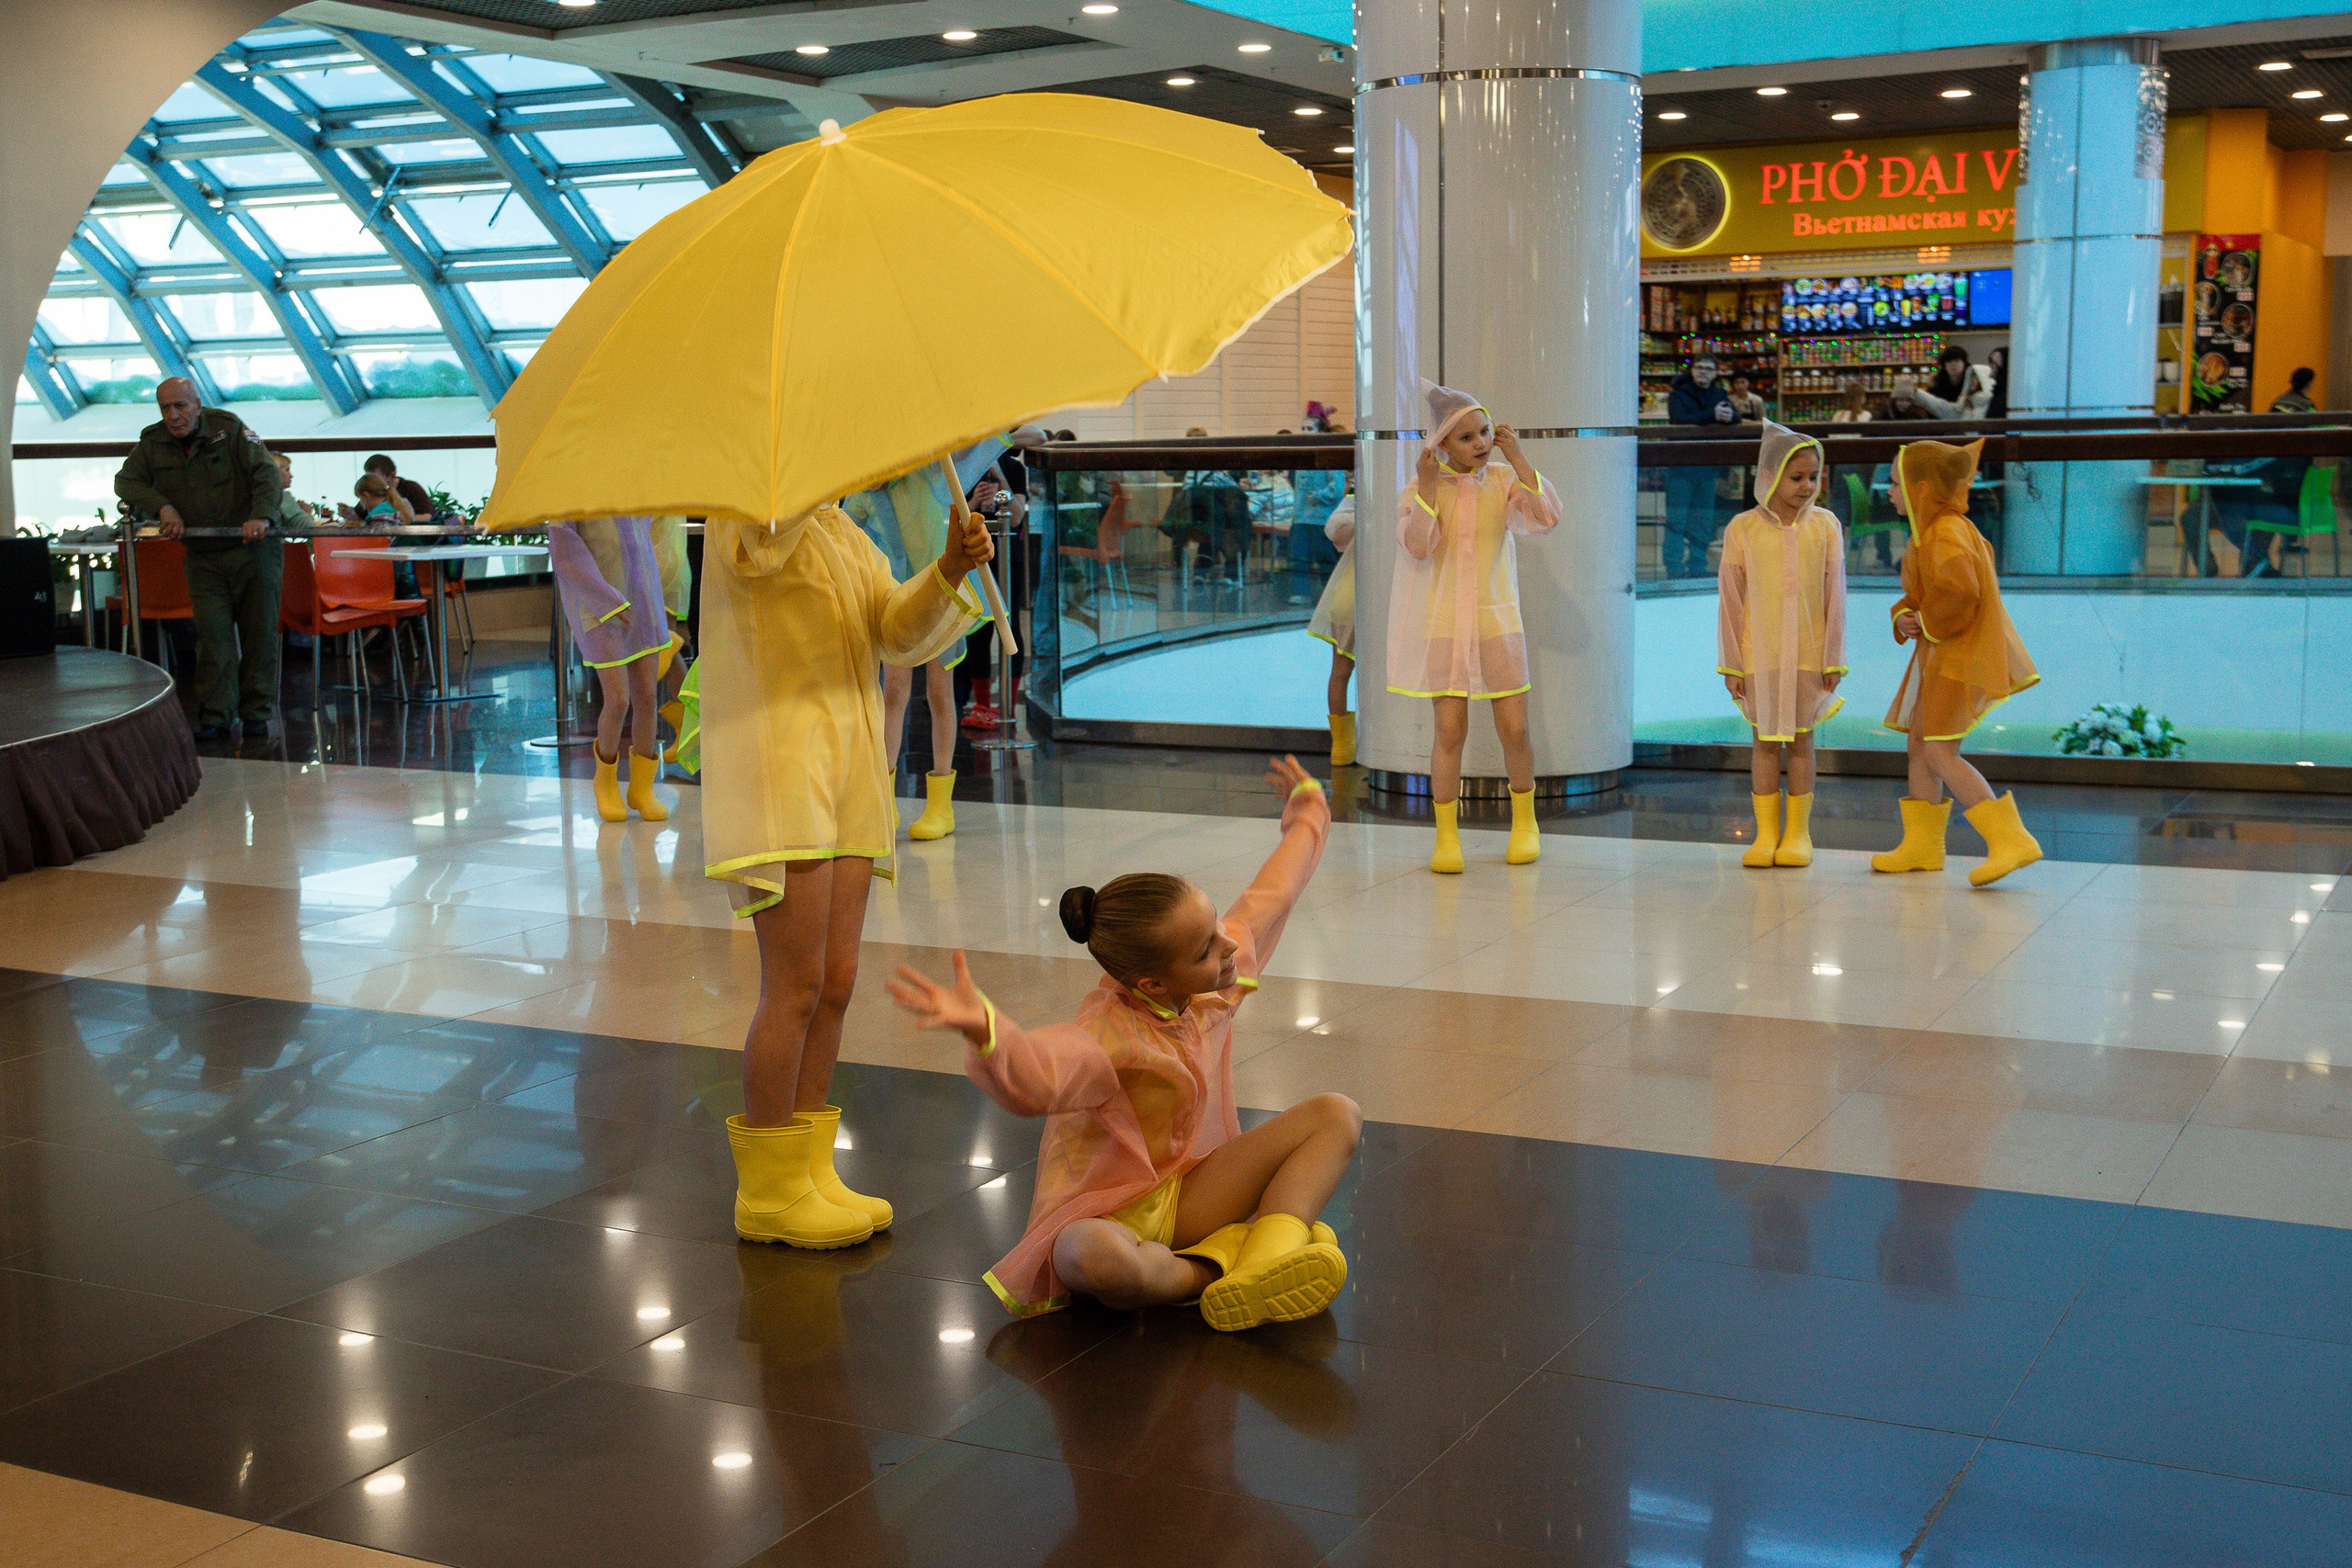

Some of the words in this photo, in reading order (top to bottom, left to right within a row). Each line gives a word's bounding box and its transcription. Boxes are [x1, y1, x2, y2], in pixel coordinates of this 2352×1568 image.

[1759, 149, 1868, 204] PHỞ
[1877, 152, 1969, 203] ĐẠI
[1792, 210, 1967, 236] Вьетнамская
